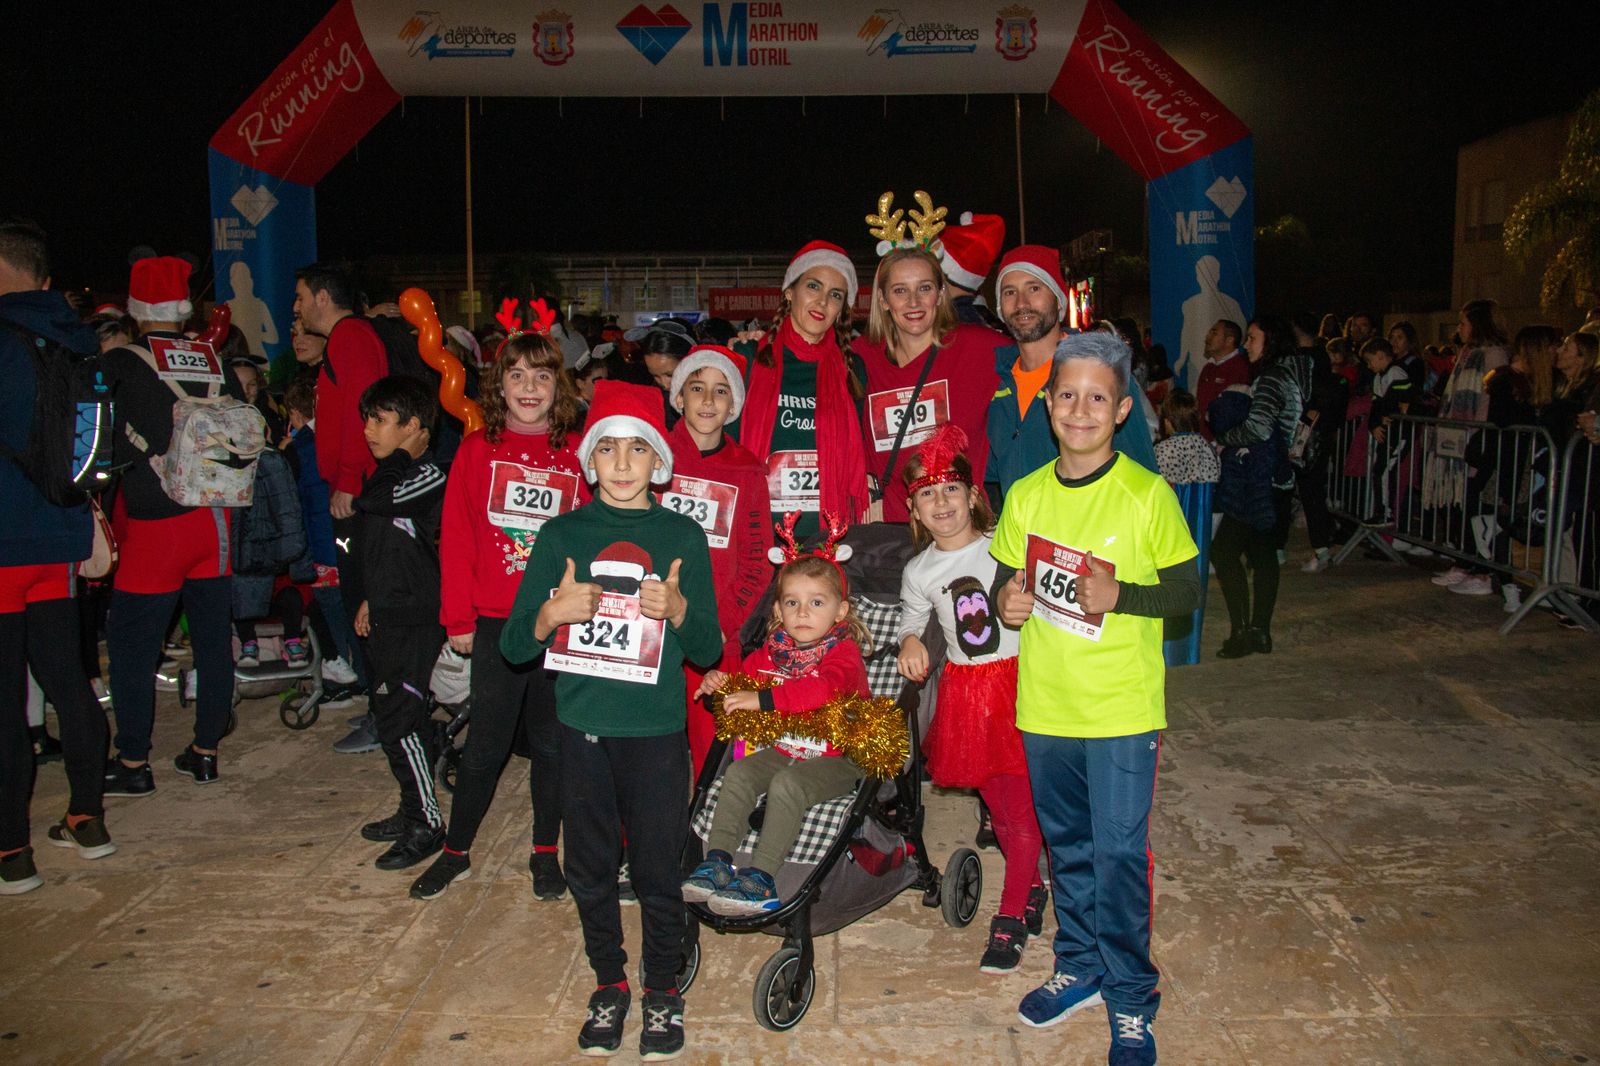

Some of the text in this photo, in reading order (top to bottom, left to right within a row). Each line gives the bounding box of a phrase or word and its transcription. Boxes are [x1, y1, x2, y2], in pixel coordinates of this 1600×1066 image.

[301, 47, 320, 75] por
[324, 27, 336, 47] el
[444, 29, 517, 48] deportes
[905, 26, 979, 44] deportes
[237, 41, 365, 157] Running
[1084, 24, 1208, 154] Running
[1171, 88, 1199, 108] por
[1200, 109, 1219, 123] el
[167, 353, 209, 368] 1325
[513, 485, 553, 511] 320
[670, 496, 709, 523] 323
[1040, 568, 1078, 604] 456
[578, 619, 630, 651] 324
